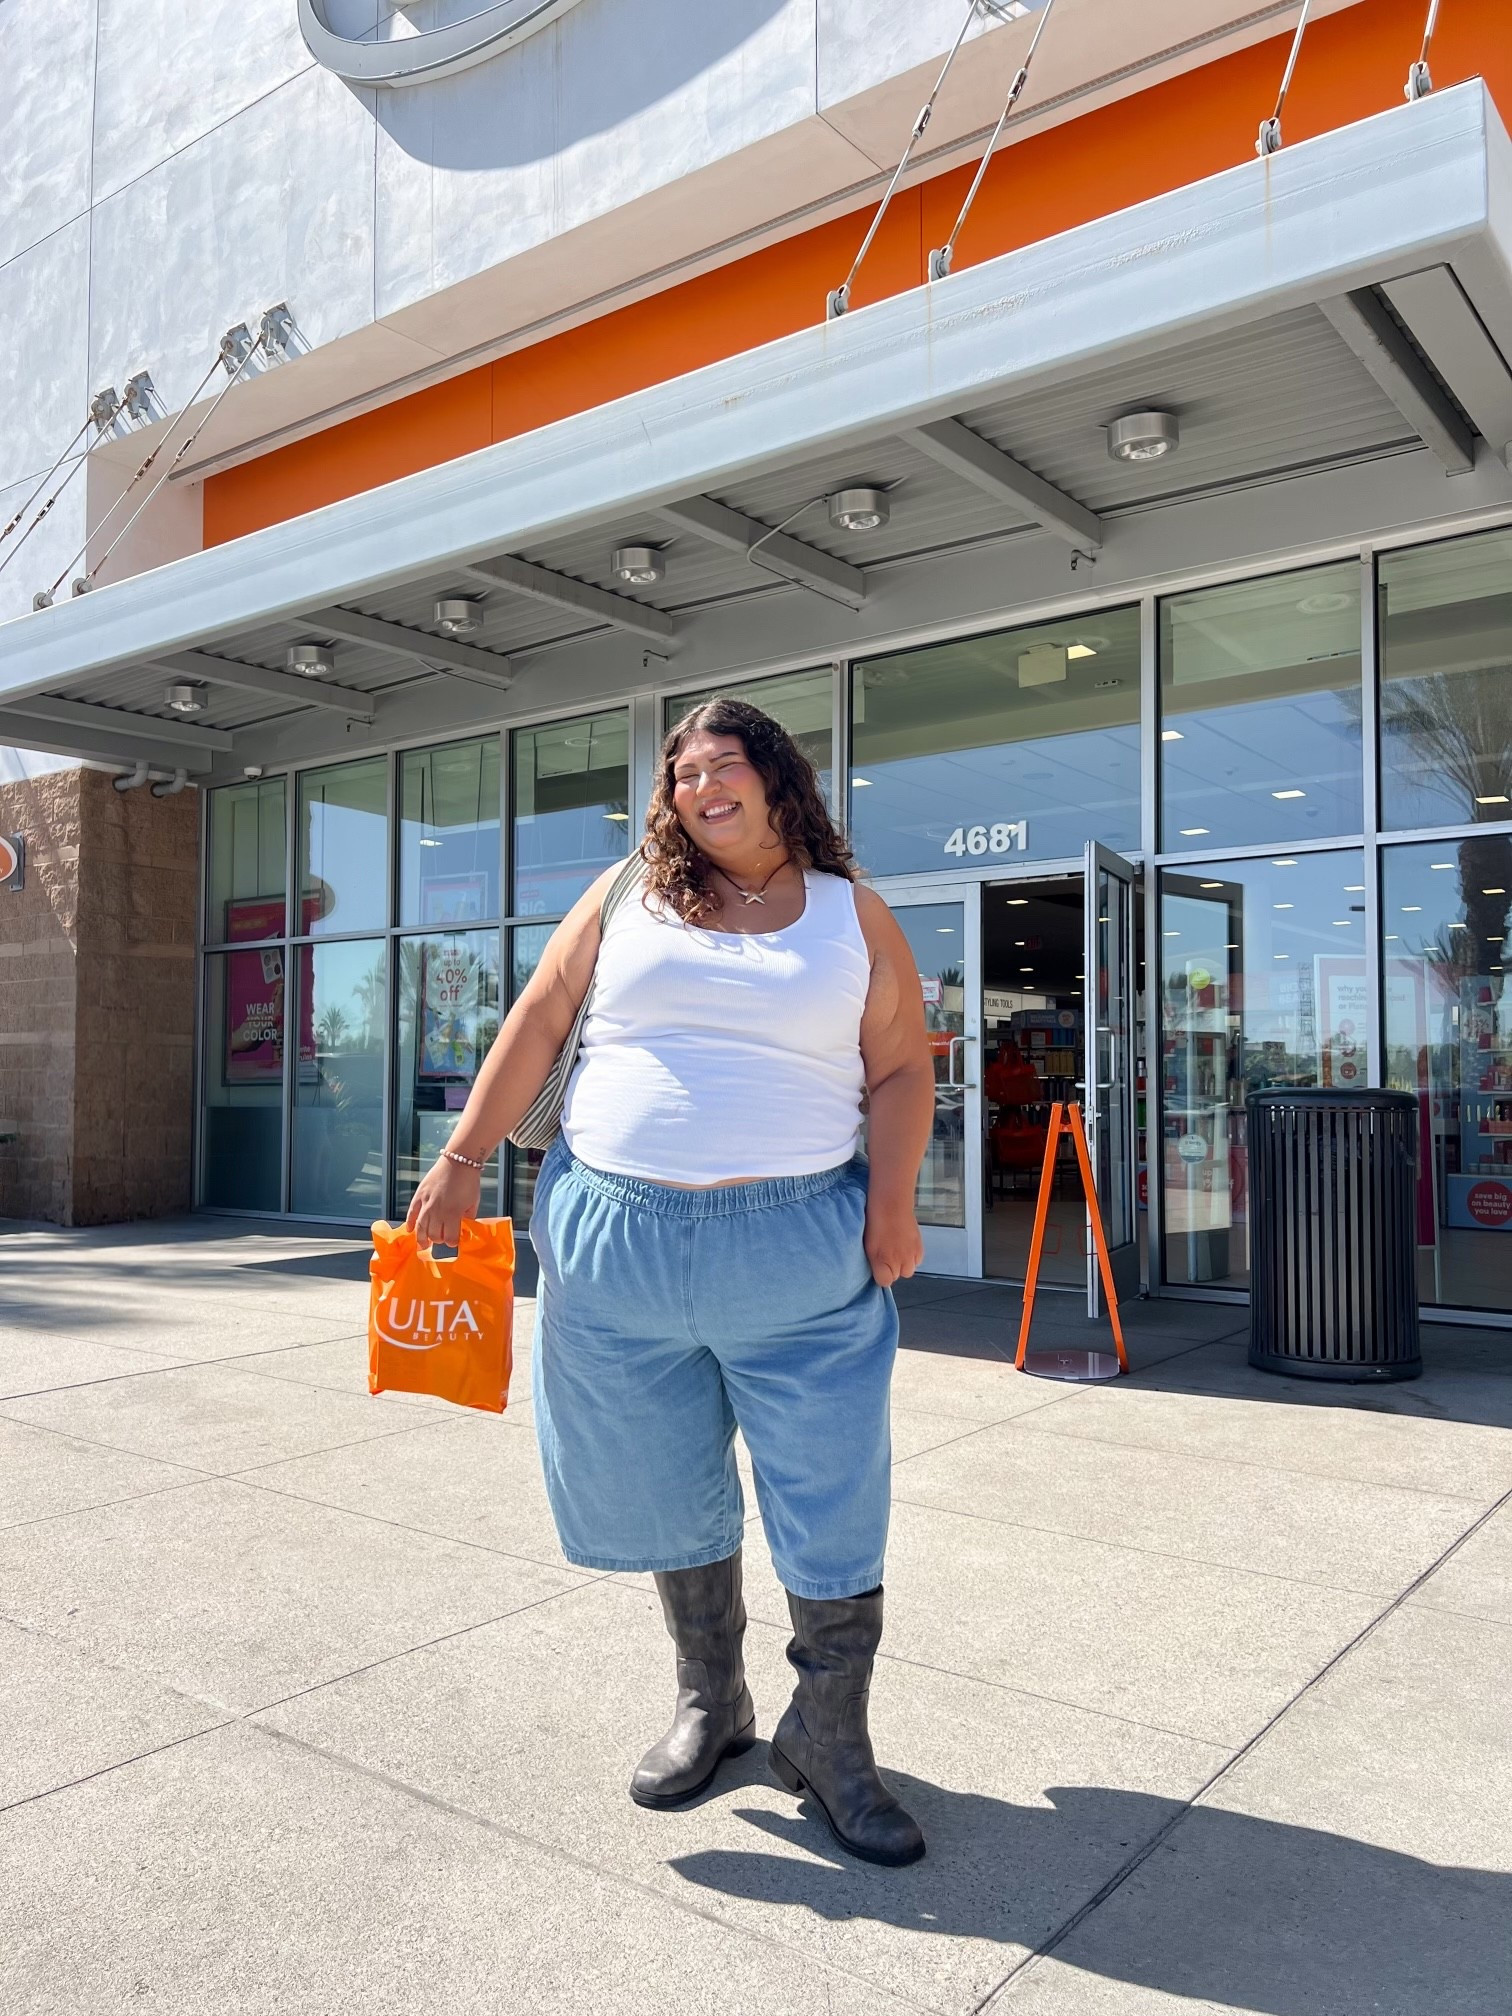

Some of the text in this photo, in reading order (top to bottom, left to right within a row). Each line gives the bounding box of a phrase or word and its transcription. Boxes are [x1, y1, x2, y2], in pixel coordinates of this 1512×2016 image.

[944, 820, 1028, 856] 4681
[443, 959, 452, 967] up
[436, 968, 468, 984] 40%
[246, 1002, 275, 1015] WEAR
[1000, 998, 1013, 1009] TOOLS
[246, 1016, 274, 1028] YOUR
[243, 1028, 278, 1042] COLOR
[1494, 1192, 1507, 1202] big
[1483, 1200, 1511, 1210] beauty
[1474, 1207, 1508, 1216] you love
[388, 1297, 479, 1333] ULTA
[412, 1331, 485, 1342] BEAUTY
